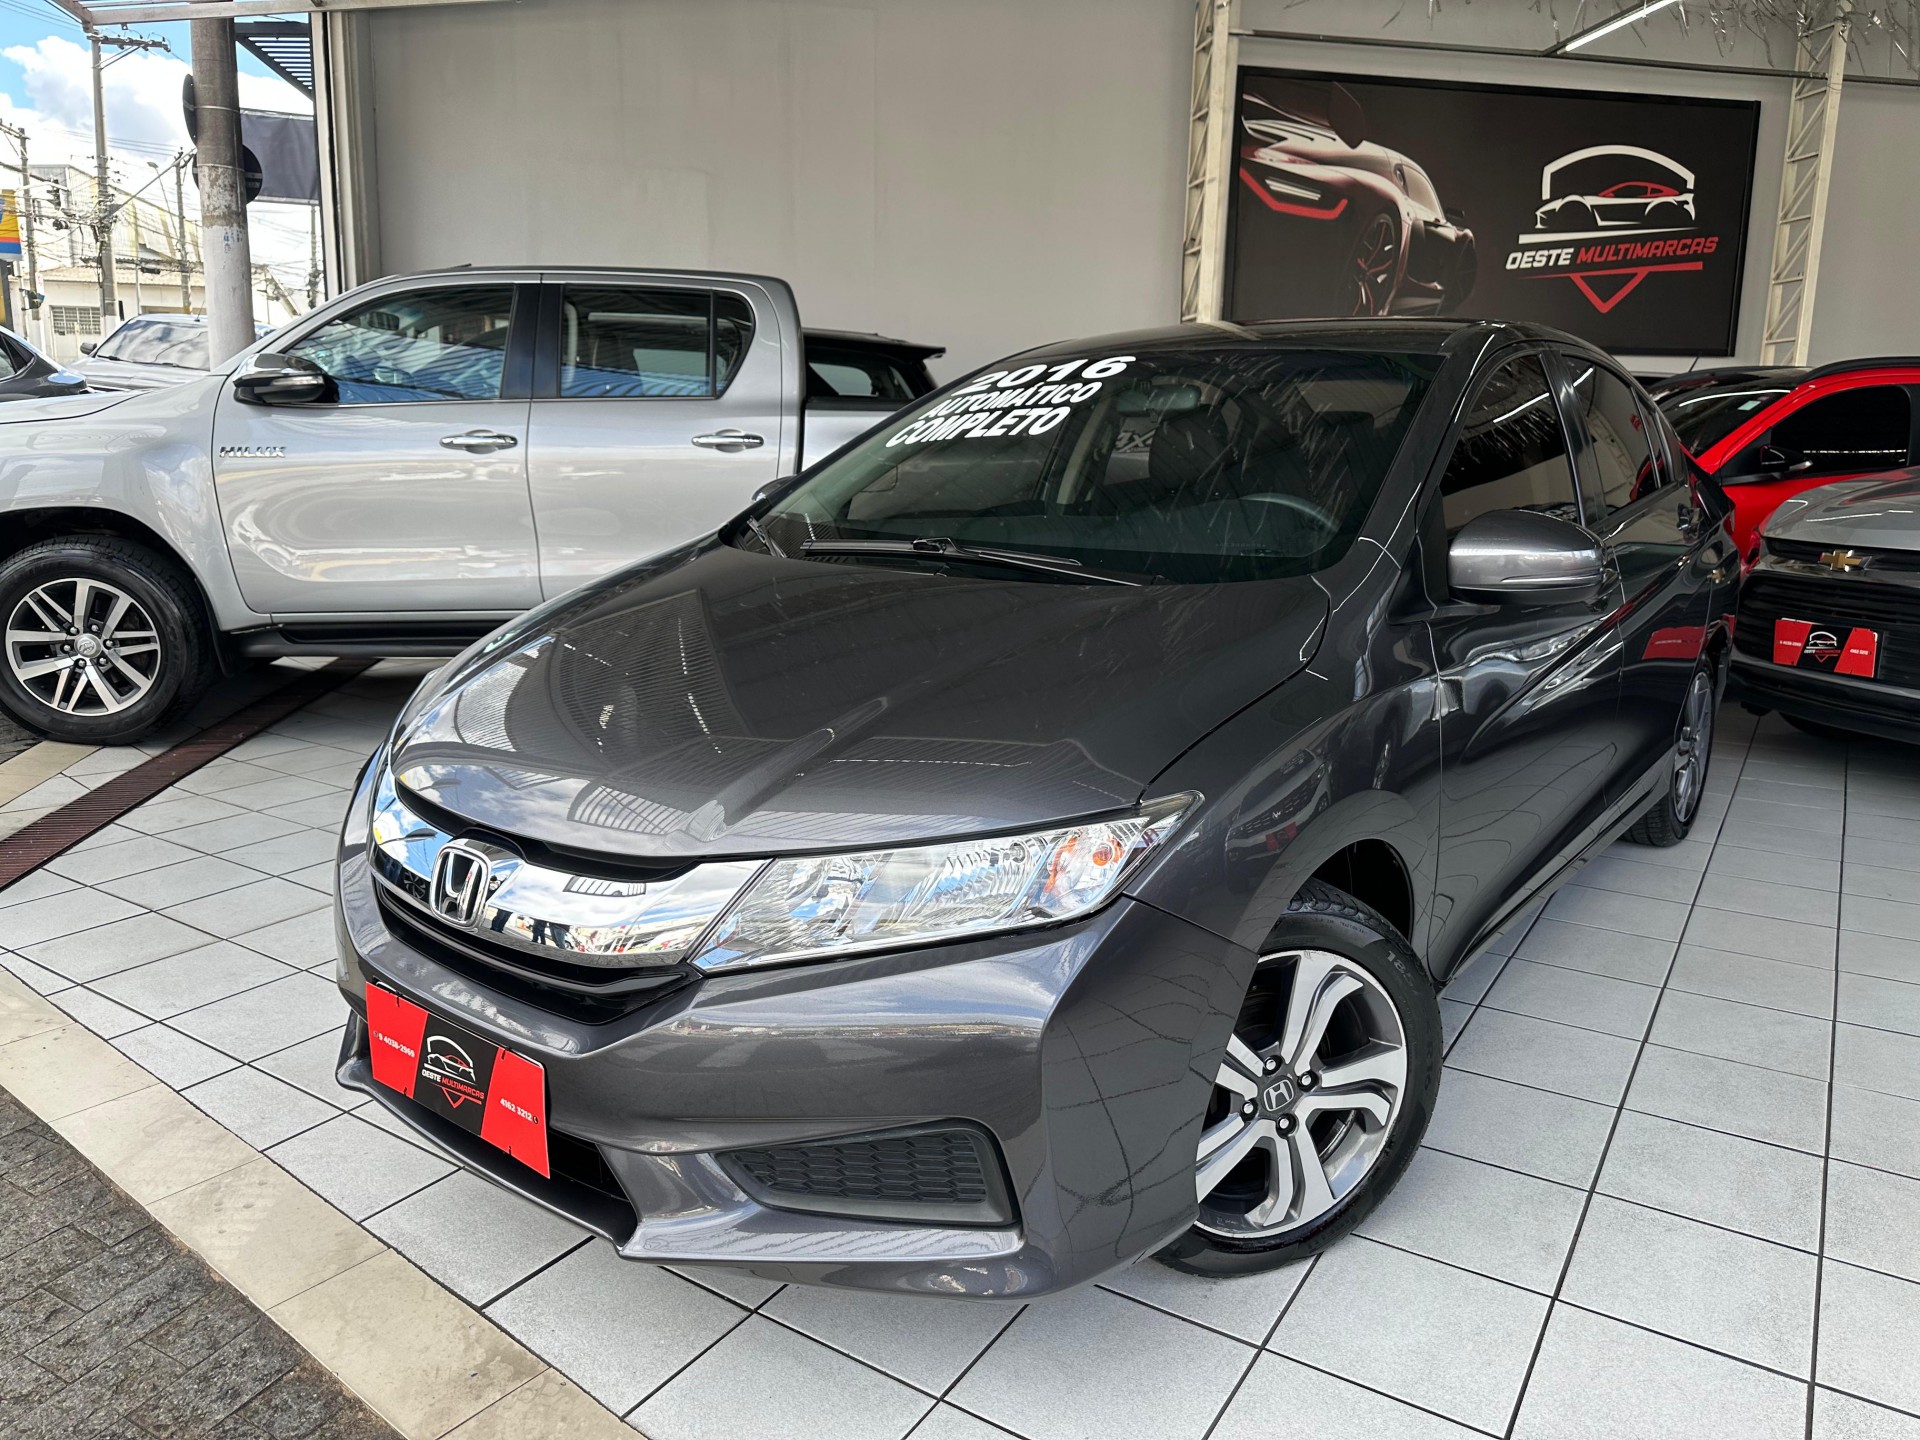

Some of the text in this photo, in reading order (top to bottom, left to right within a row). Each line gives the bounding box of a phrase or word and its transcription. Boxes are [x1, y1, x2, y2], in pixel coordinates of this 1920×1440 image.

[1505, 237, 1719, 270] OESTE MULTIMARCAS
[951, 356, 1136, 396] 2016
[918, 381, 1102, 420] AUTOMÁTICO
[885, 406, 1071, 447] COMPLETO
[219, 446, 286, 458] HILUX
[421, 1069, 485, 1099] OESTE MULTIMARCAS
[500, 1098, 533, 1122] 4162 3212
